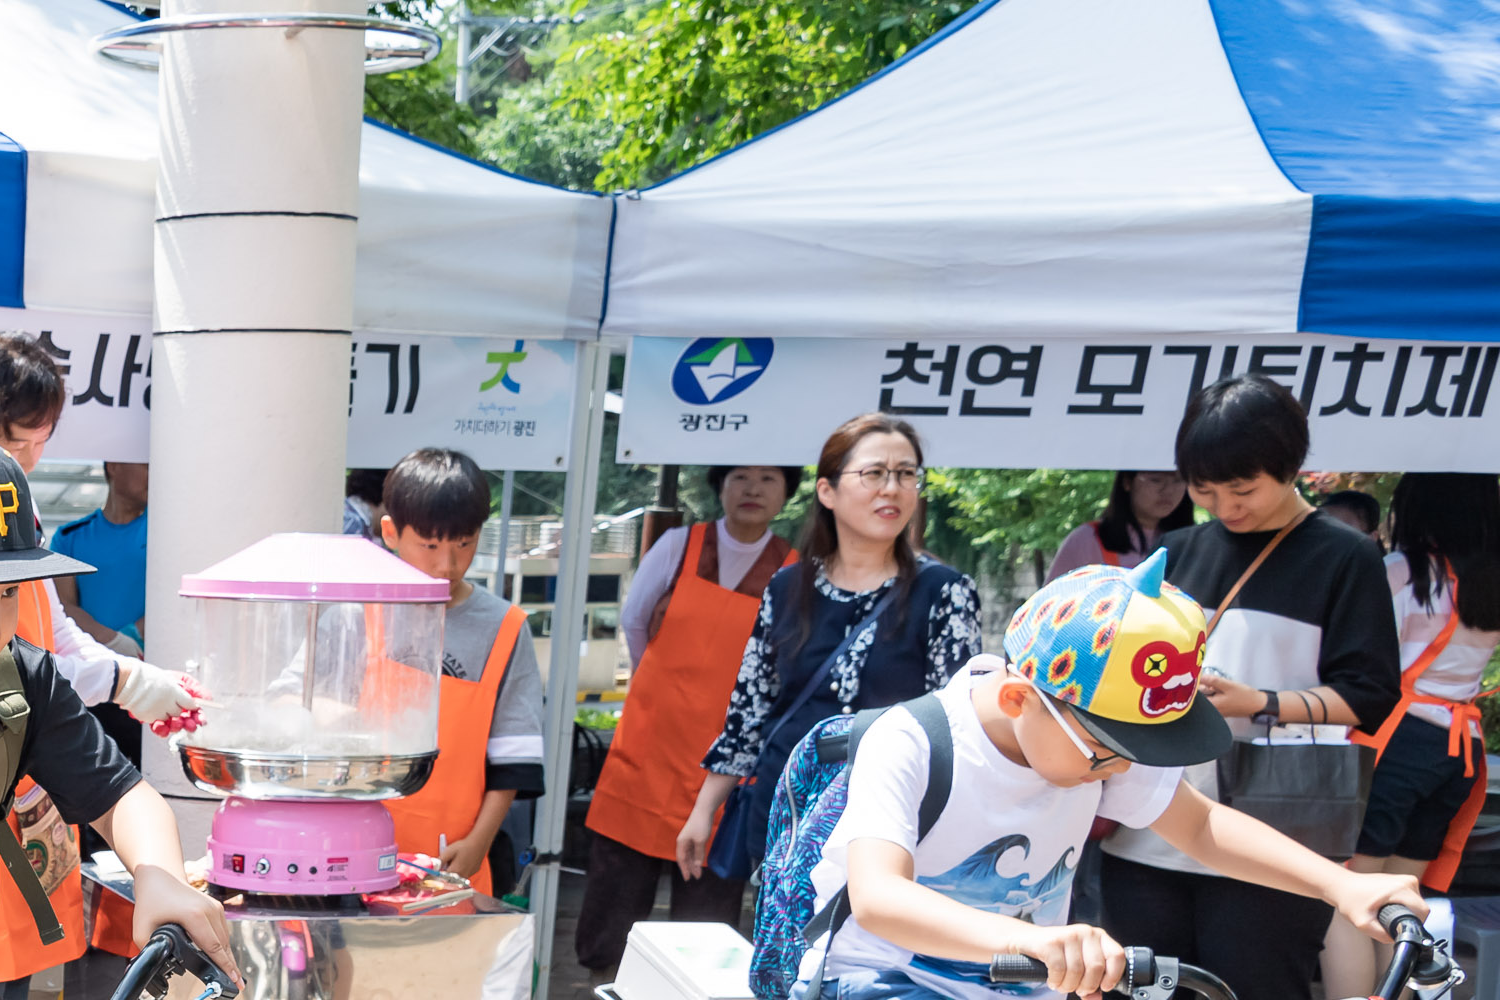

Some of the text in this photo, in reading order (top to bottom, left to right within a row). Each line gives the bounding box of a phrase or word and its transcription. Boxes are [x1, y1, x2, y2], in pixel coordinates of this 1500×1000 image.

[878, 342, 1044, 417] 천연
[513, 420, 536, 437] 광진
[679, 414, 749, 432] 광진구
